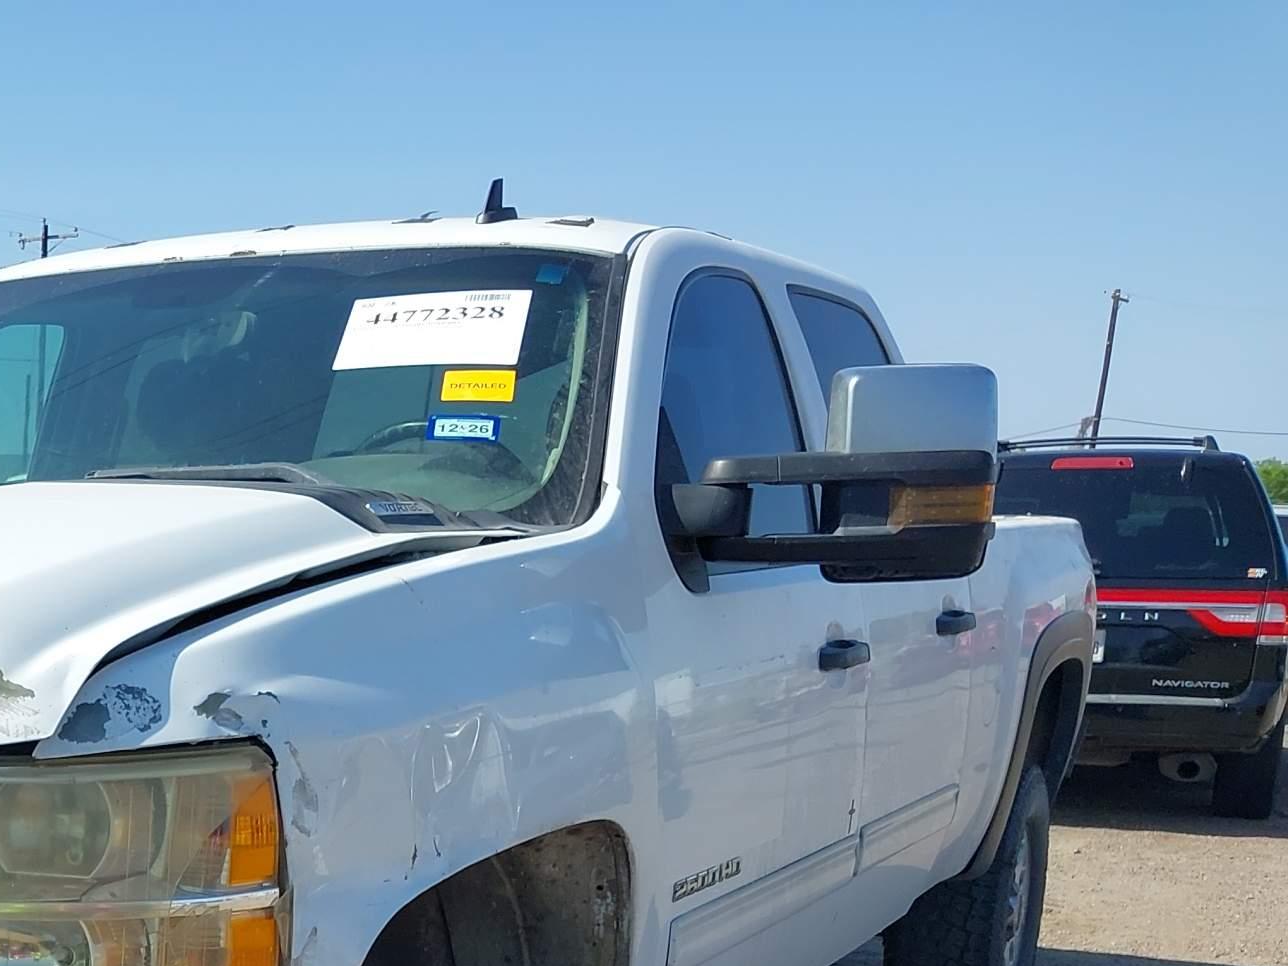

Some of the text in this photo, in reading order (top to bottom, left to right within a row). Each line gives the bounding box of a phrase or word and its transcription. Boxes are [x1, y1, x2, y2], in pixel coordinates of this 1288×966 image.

[366, 306, 505, 325] 44772328
[449, 381, 508, 391] DETAILED
[1151, 678, 1230, 690] NAVIGATOR
